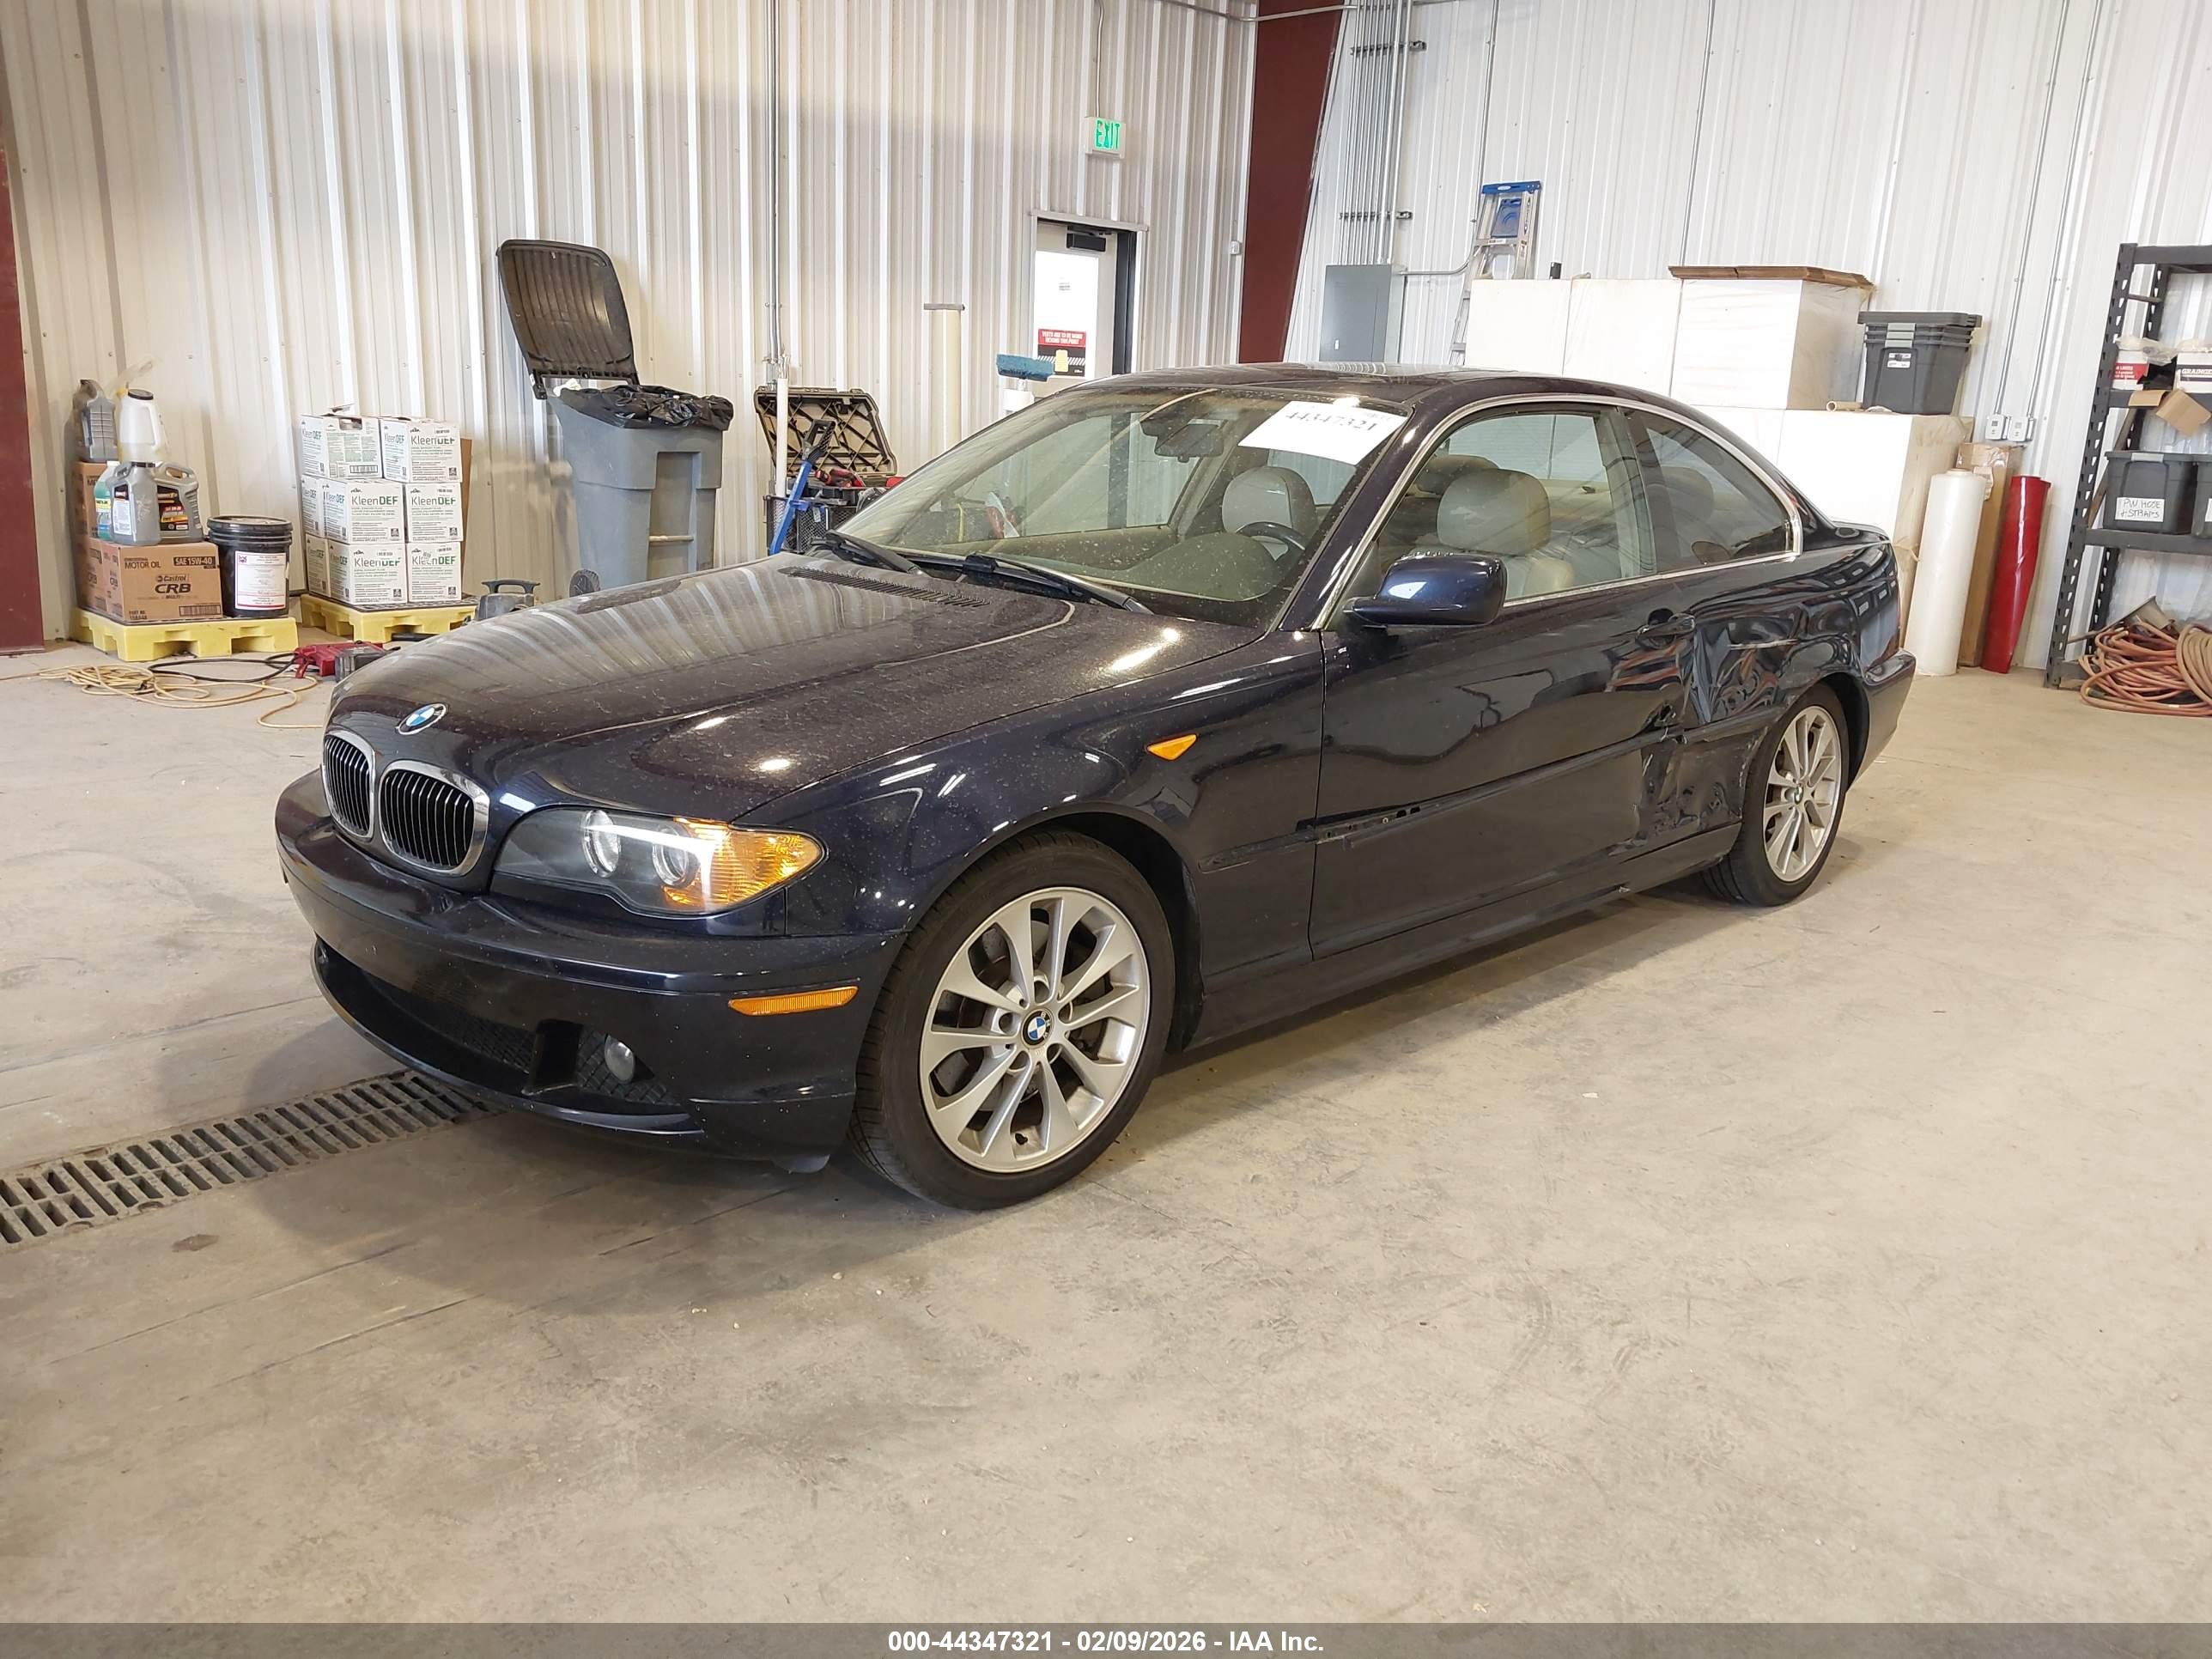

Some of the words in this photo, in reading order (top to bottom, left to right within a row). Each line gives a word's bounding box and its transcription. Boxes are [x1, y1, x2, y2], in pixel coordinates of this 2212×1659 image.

[1096, 119, 1120, 150] EXIT
[1286, 412, 1377, 431] 44347321
[410, 434, 455, 446] KleenDEF
[351, 495, 398, 506] KleenDEF
[411, 495, 456, 506] KleenDEF
[2124, 499, 2138, 508] PW
[2141, 501, 2160, 509] HOSE
[125, 561, 149, 569] MOTOR
[175, 557, 188, 566] SAE
[188, 556, 212, 565] 15W-40
[354, 557, 400, 568] KleenDEF
[155, 583, 191, 594] CRB
